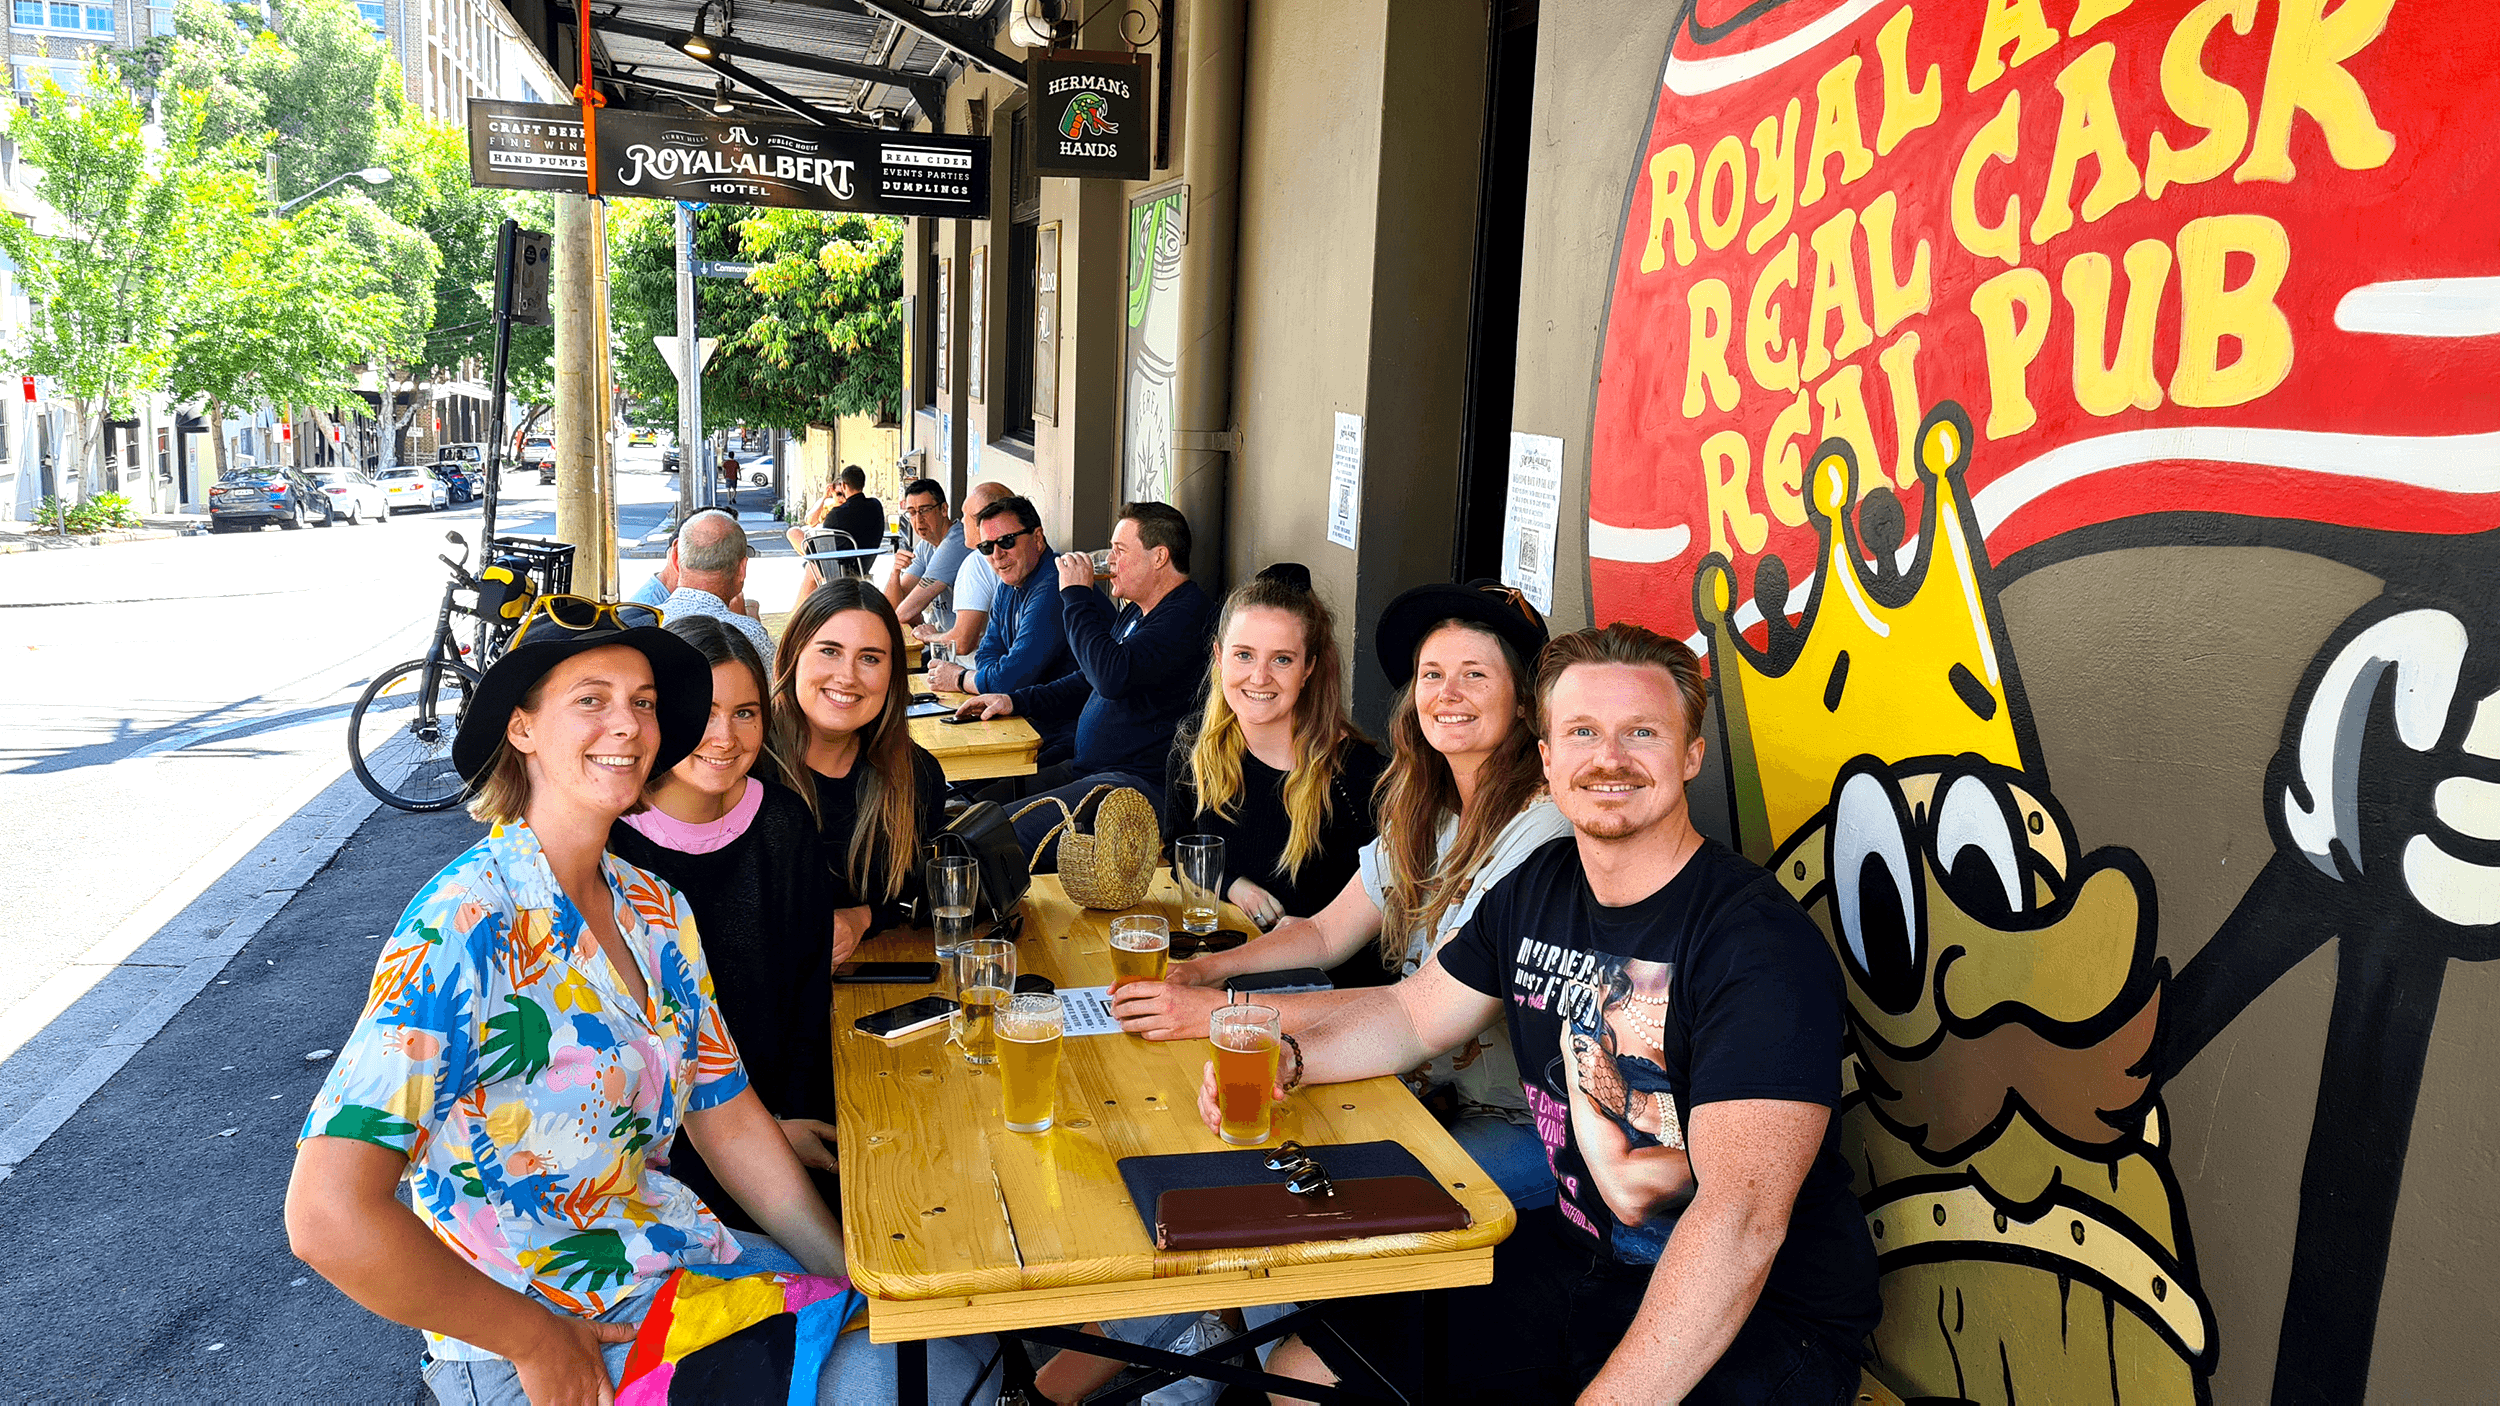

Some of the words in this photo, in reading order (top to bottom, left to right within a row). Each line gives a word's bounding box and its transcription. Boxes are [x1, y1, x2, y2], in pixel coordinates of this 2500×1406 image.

[1048, 75, 1130, 99] HERMAN'S
[488, 122, 541, 135] CRAFT
[489, 137, 531, 148] FINE
[661, 133, 687, 142] SURRY
[688, 135, 709, 143] HILLS
[767, 138, 794, 147] PUBLIC
[795, 143, 819, 151] HOUSE
[1641, 4, 1942, 275] ROYAL
[1059, 141, 1118, 157] HANDS
[493, 154, 532, 164] HAND
[540, 158, 586, 167] PUMPS
[886, 153, 919, 163] REAL
[927, 156, 968, 166] CIDER
[618, 144, 734, 186] ROYAL
[730, 152, 854, 200] ALBERT
[883, 168, 923, 178] EVENTS
[927, 171, 970, 180] PARTIES
[710, 183, 771, 196] HOTEL
[882, 181, 968, 195] DUMPLINGS
[1682, 190, 1932, 419] REAL
[1951, 0, 2396, 264] CASK
[1972, 214, 2295, 440] PUB
[1515, 968, 1544, 992] MOST
